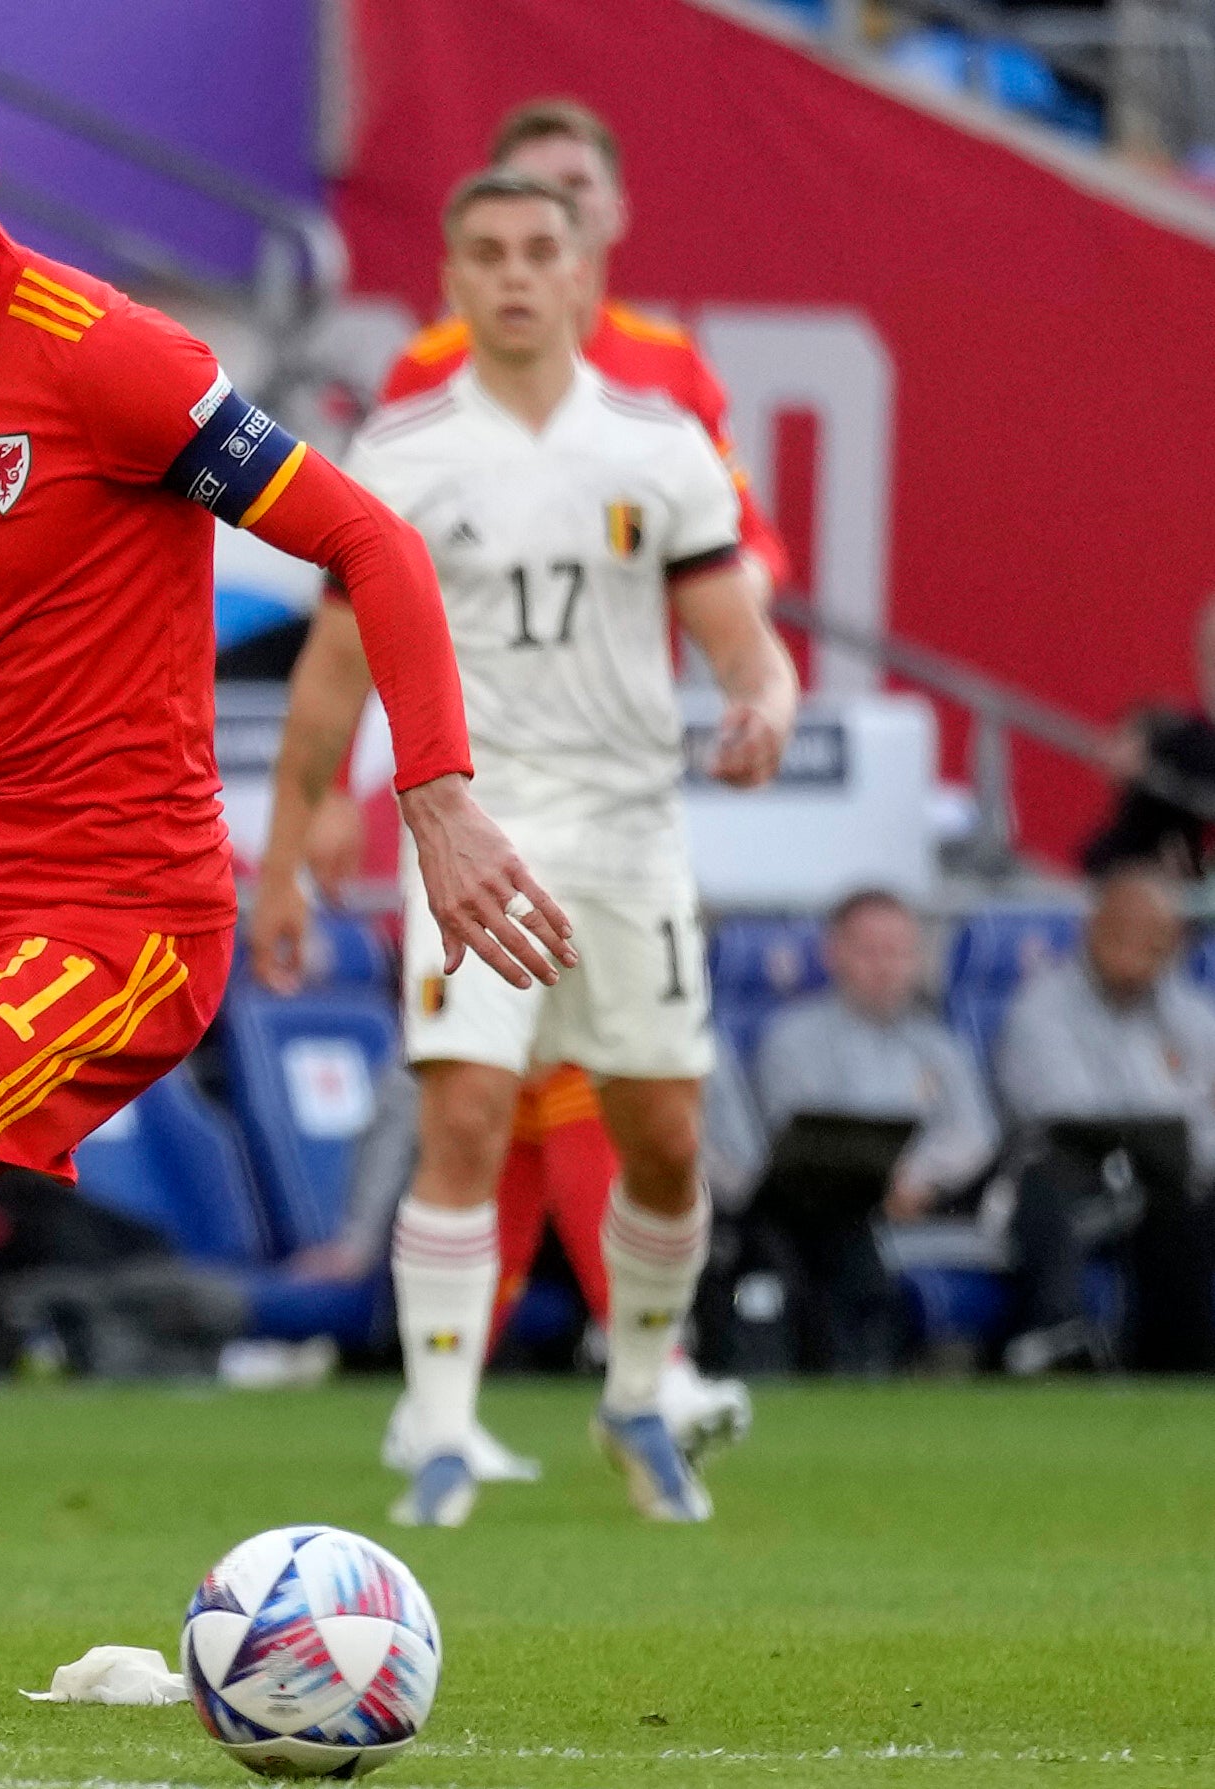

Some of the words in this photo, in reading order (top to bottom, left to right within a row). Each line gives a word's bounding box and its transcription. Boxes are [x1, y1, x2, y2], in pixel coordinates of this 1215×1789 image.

[244, 409, 270, 438] RES
[192, 472, 219, 503] ECT
[510, 563, 583, 648] 17
[659, 917, 688, 1003] 1
